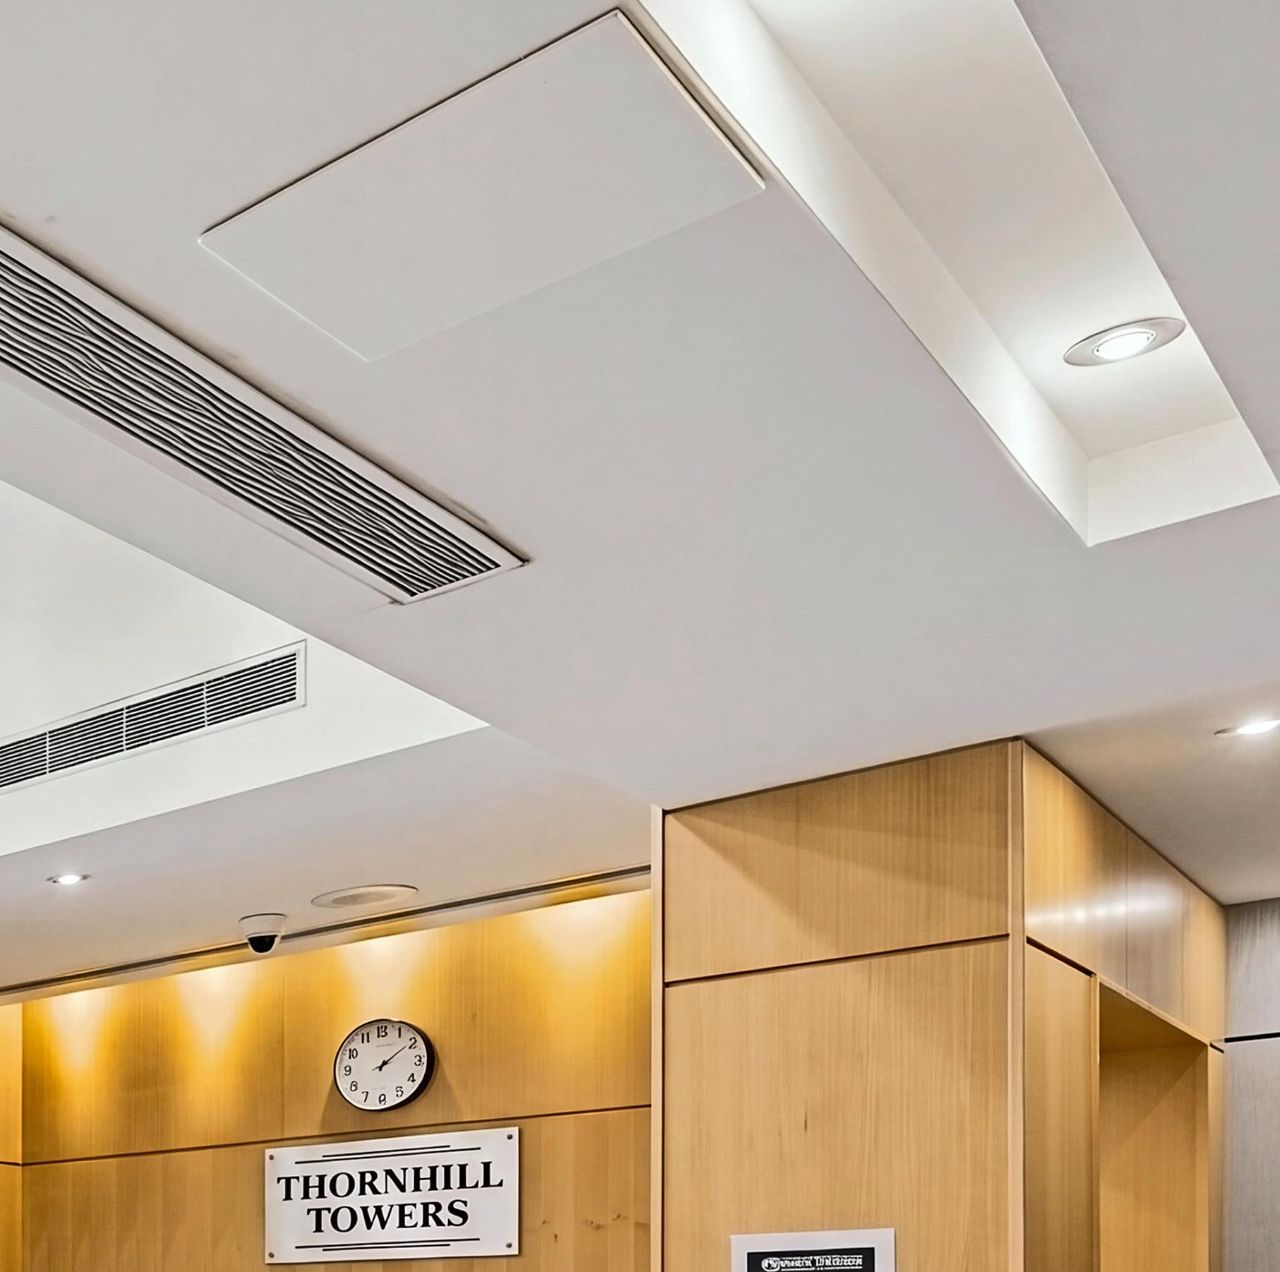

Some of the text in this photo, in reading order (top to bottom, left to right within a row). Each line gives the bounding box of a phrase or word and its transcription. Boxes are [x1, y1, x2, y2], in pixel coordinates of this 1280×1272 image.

[361, 1031, 370, 1044] 11
[397, 1025, 402, 1038] 1
[408, 1036, 417, 1049] 2
[348, 1047, 358, 1059] 10
[414, 1054, 422, 1067] 3
[343, 1065, 352, 1076] 9
[407, 1072, 416, 1082] 4
[361, 1091, 369, 1103] 7
[276, 1161, 504, 1202] THORNHILL
[306, 1199, 469, 1233] TOWERS
